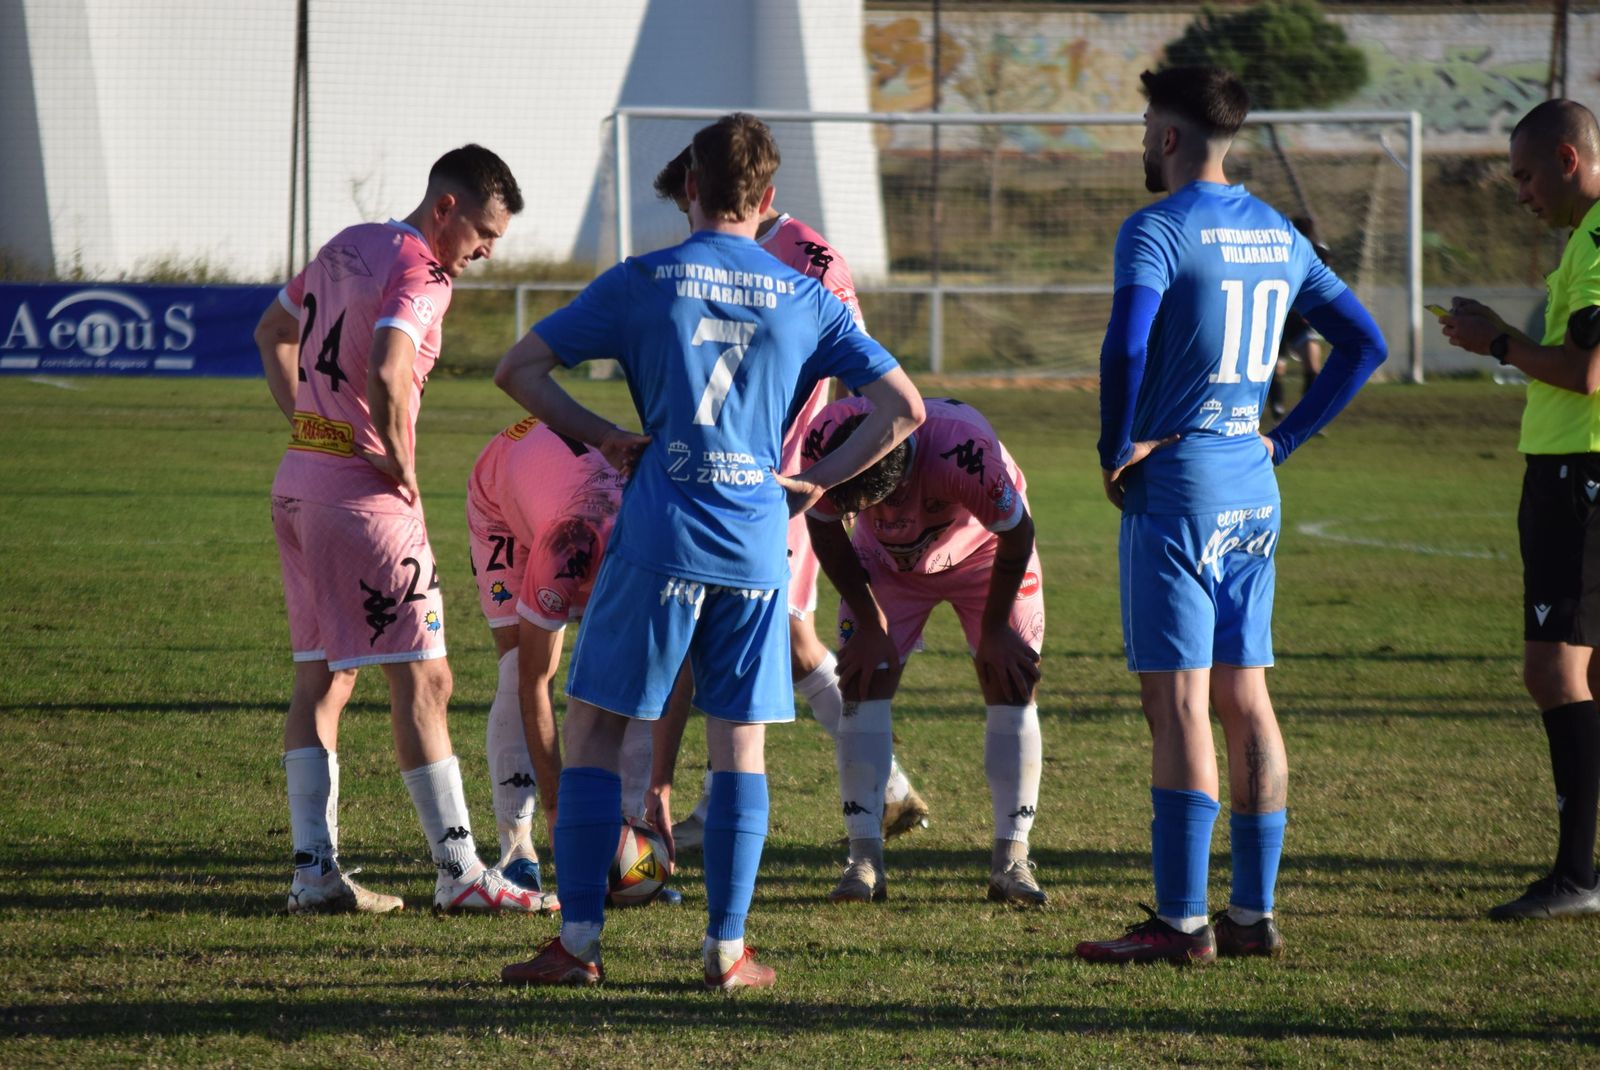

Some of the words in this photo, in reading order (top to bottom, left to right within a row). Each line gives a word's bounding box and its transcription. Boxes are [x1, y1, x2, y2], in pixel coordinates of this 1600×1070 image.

[1220, 246, 1289, 264] VILLARALBO
[655, 263, 774, 291] AYUNTAMIENTO
[776, 279, 796, 296] DE
[675, 280, 778, 310] VILLARALBO
[298, 293, 350, 393] 24
[1208, 279, 1290, 384] 10
[691, 317, 758, 427] 7
[696, 467, 764, 486] ZAMORA
[486, 535, 514, 572] 21
